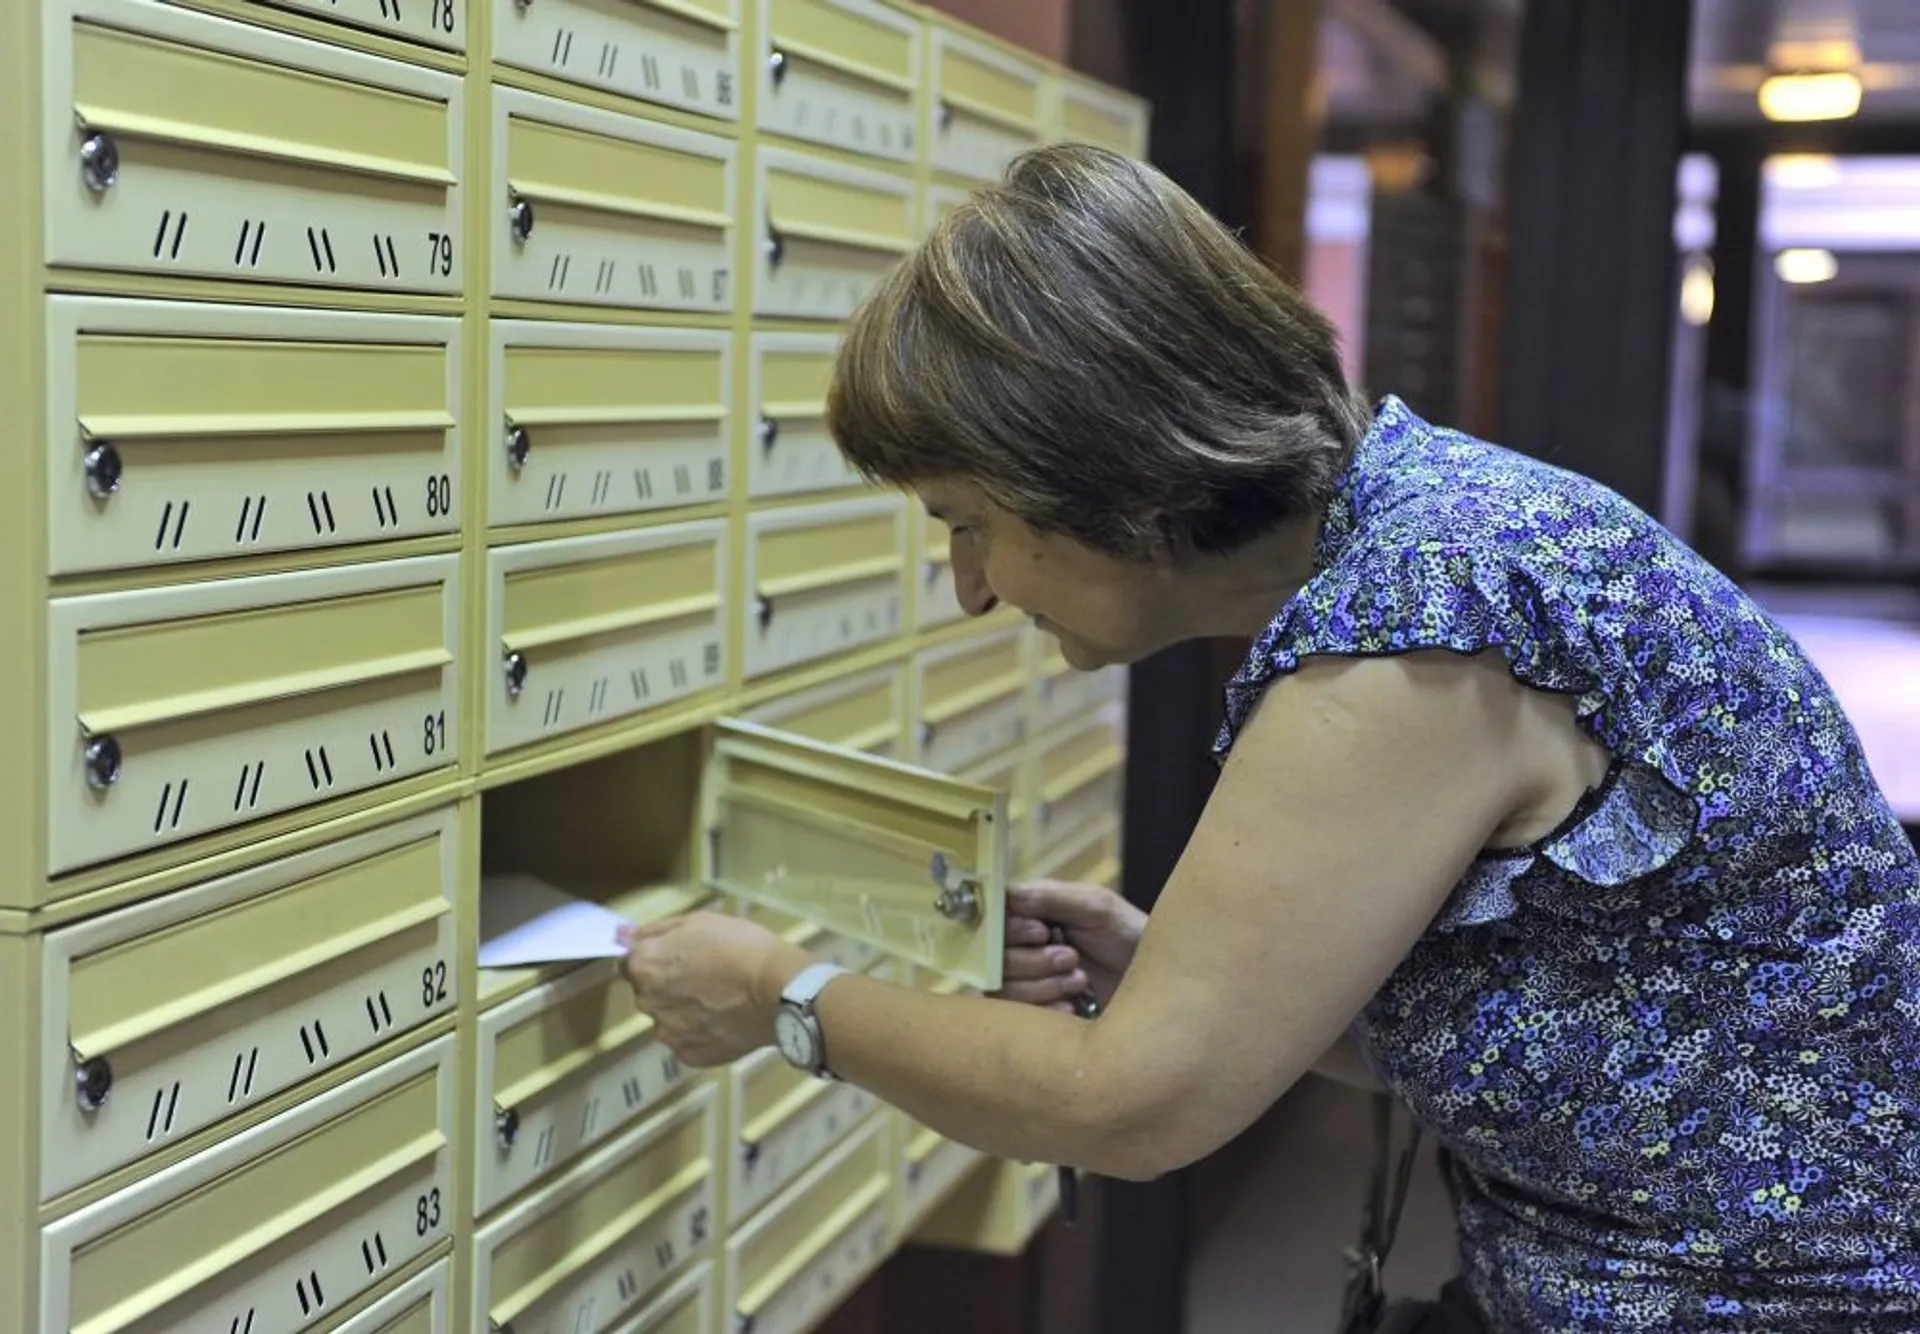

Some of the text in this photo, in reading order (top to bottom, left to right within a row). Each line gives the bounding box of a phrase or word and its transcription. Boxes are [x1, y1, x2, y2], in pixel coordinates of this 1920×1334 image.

[428, 232, 453, 277] 79
[426, 474, 451, 518] 80
[424, 710, 446, 756] 81
[422, 960, 447, 1007] 82
[416, 1186, 442, 1237] 83
